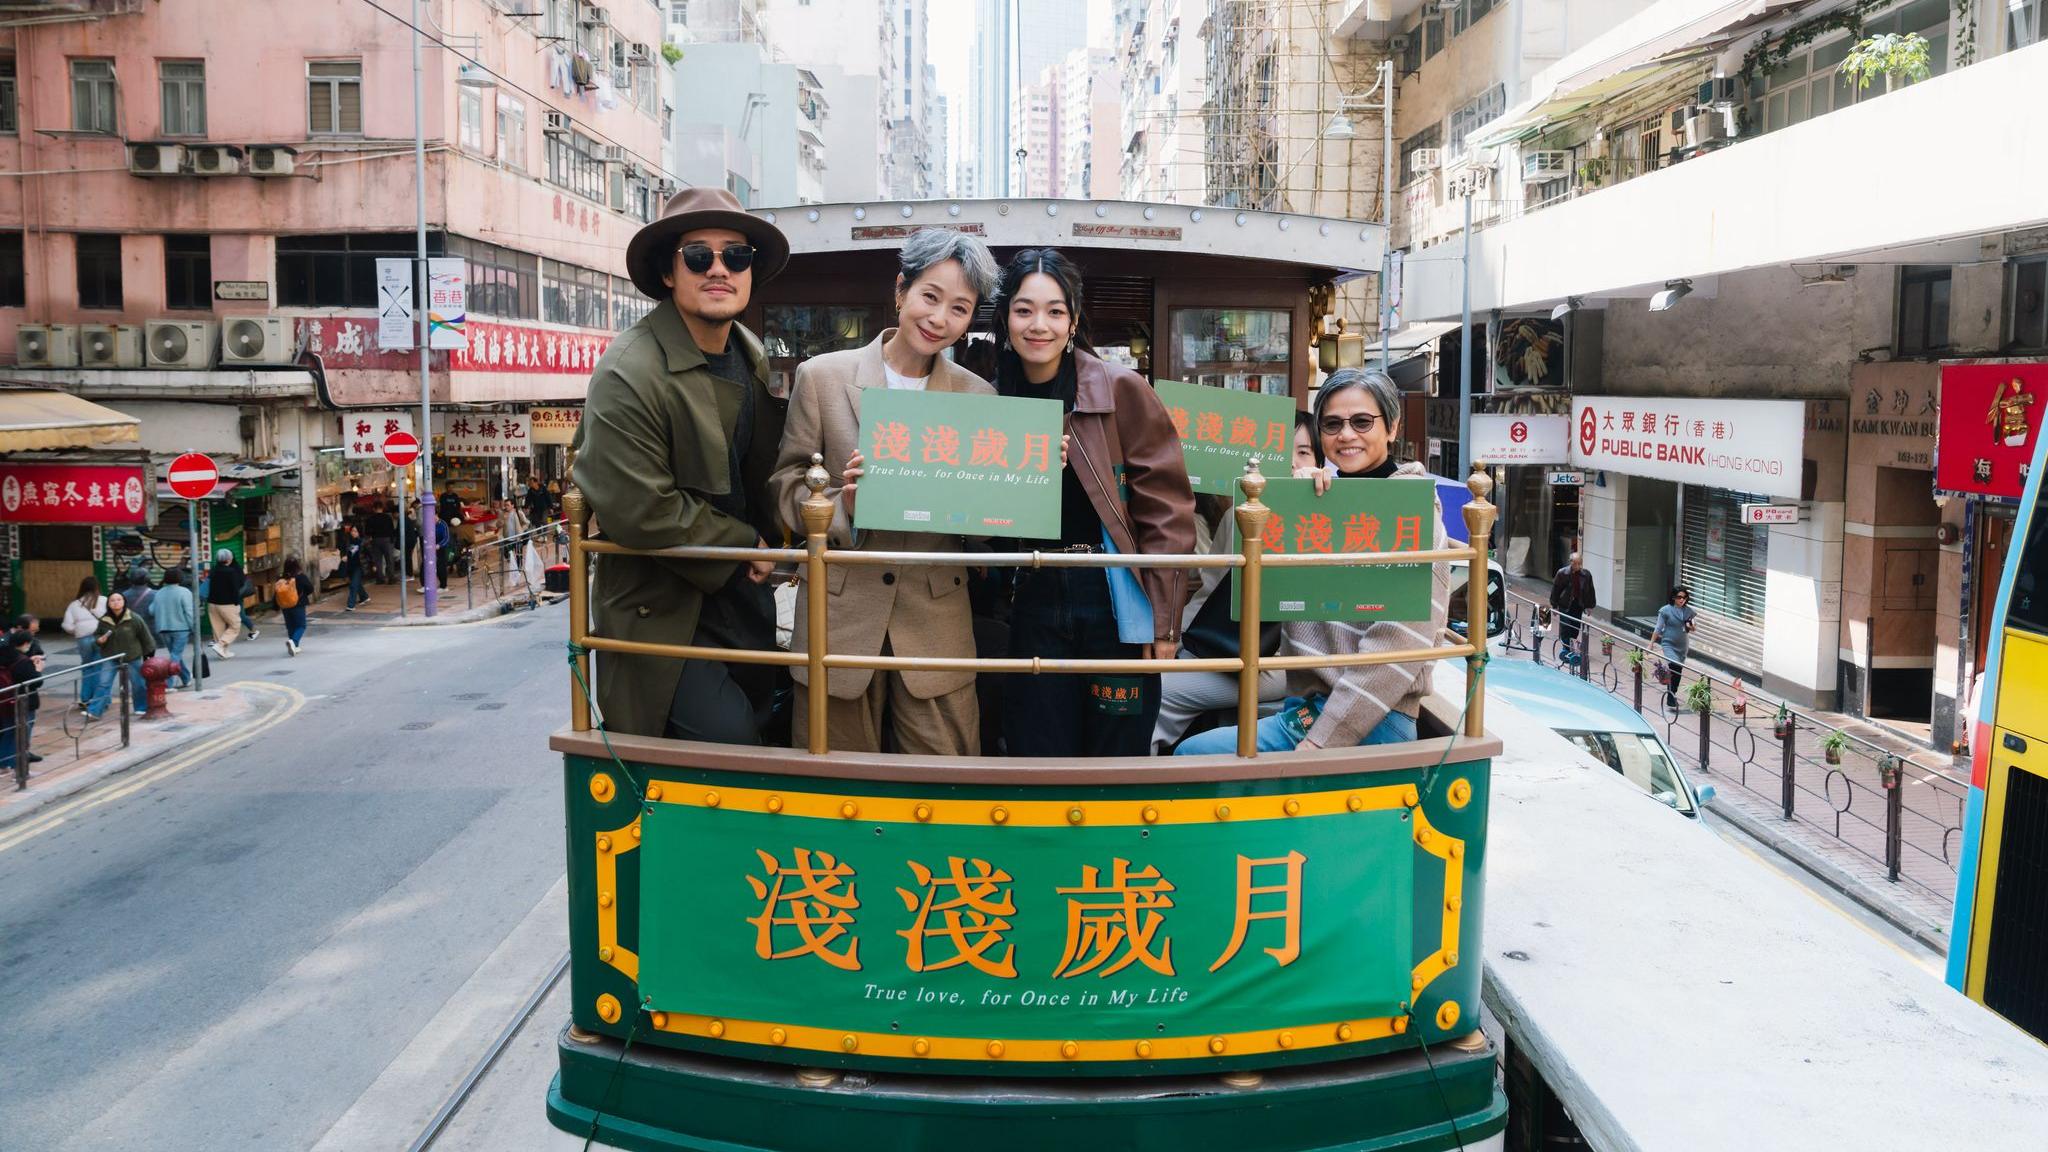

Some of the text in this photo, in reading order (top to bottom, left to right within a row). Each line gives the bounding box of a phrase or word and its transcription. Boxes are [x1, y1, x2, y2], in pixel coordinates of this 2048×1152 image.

[450, 418, 526, 440] 林橋記
[1852, 419, 1880, 434] KAM
[1880, 420, 1918, 436] KWAN
[872, 420, 1050, 472] 淺淺歲月
[1204, 445, 1217, 453] for
[1220, 447, 1240, 457] Once
[1242, 449, 1250, 458] in
[1268, 453, 1285, 462] Life
[1601, 438, 1783, 477] PUBLIC BANK (HONG KONG)
[869, 465, 1050, 485] True love, for Once in My Life
[22, 481, 123, 507] 燕窩冬蟲草
[745, 846, 1309, 980] 淺淺歲月
[863, 984, 1188, 1008] True love, for Once in My Life
